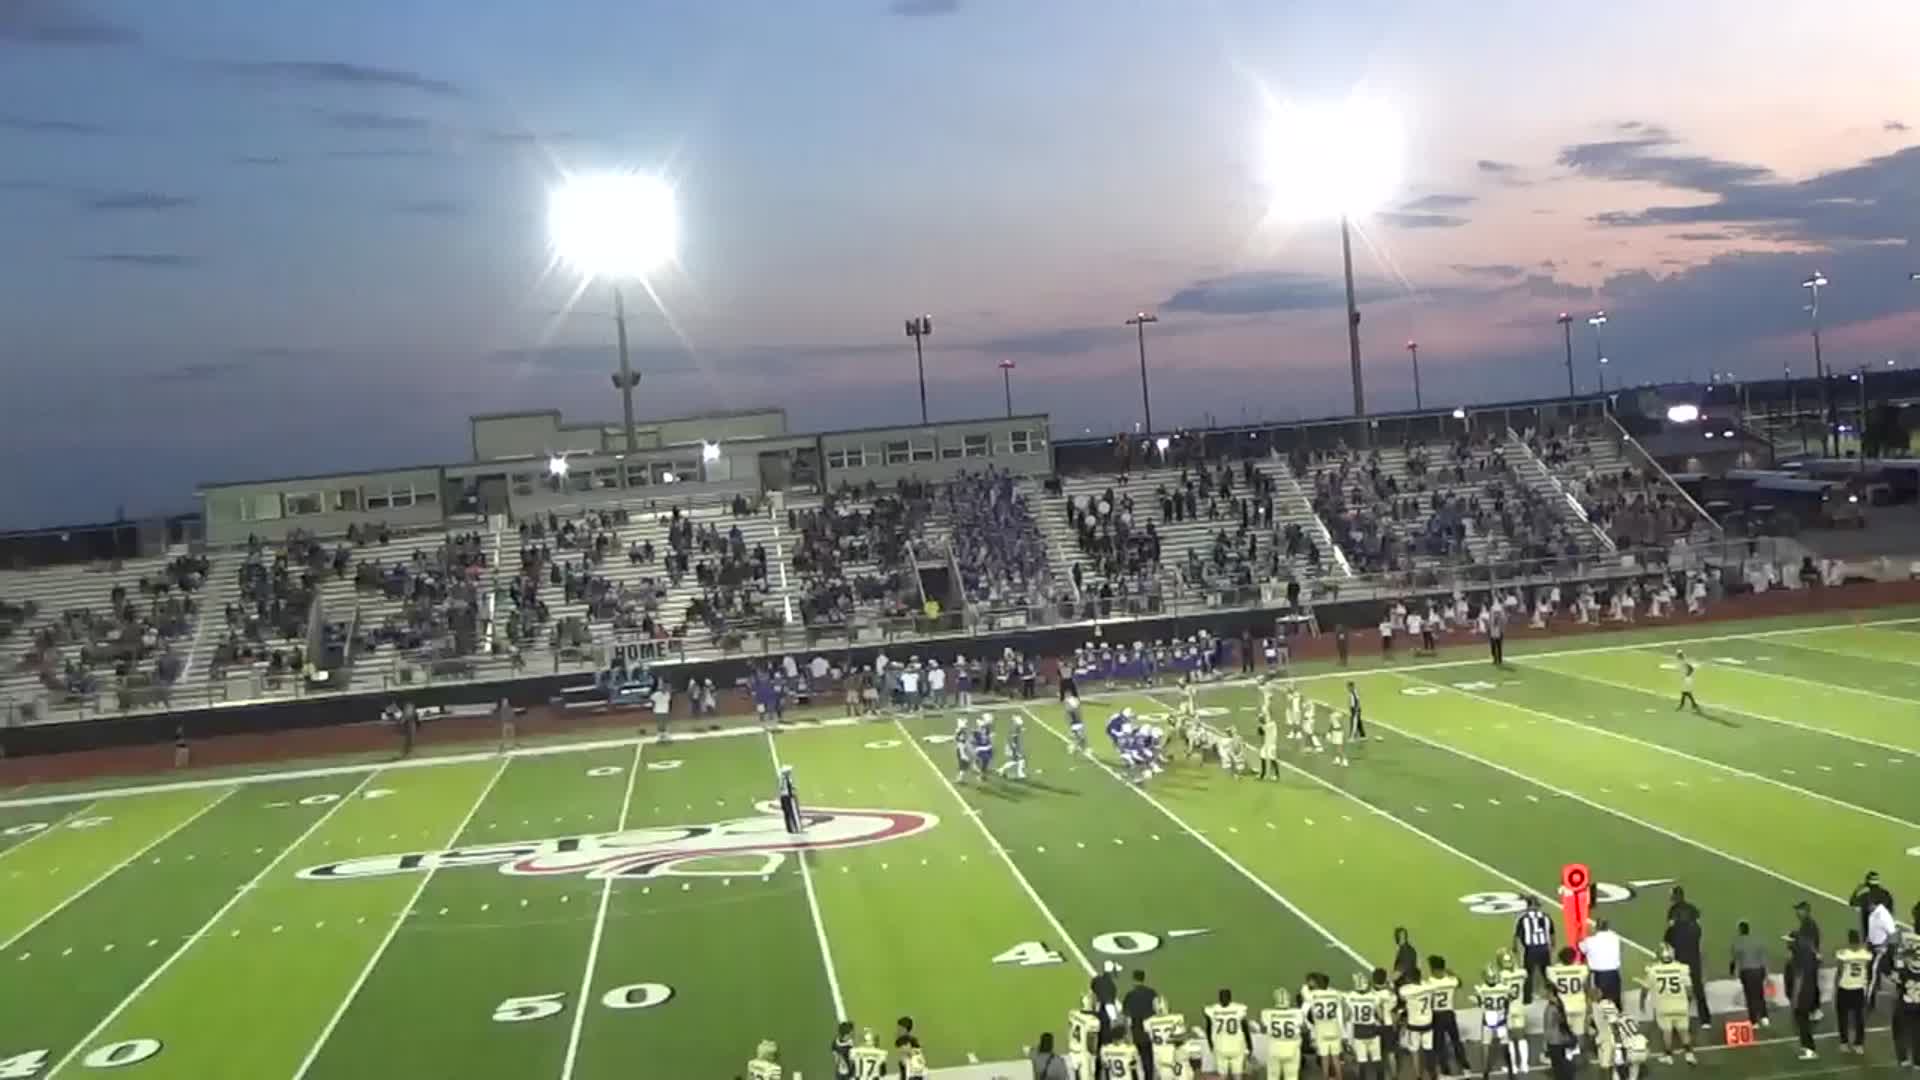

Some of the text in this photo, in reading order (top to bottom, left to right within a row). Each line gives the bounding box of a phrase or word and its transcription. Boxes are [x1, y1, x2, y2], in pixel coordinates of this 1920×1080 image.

[615, 641, 668, 660] HOME
[1557, 977, 1581, 994] 50
[1656, 977, 1681, 994] 75
[1313, 1001, 1338, 1020] 32
[1215, 1018, 1238, 1035] 70
[1271, 1020, 1296, 1039] 56
[1727, 1023, 1753, 1044] 30
[859, 1057, 877, 1078] 17
